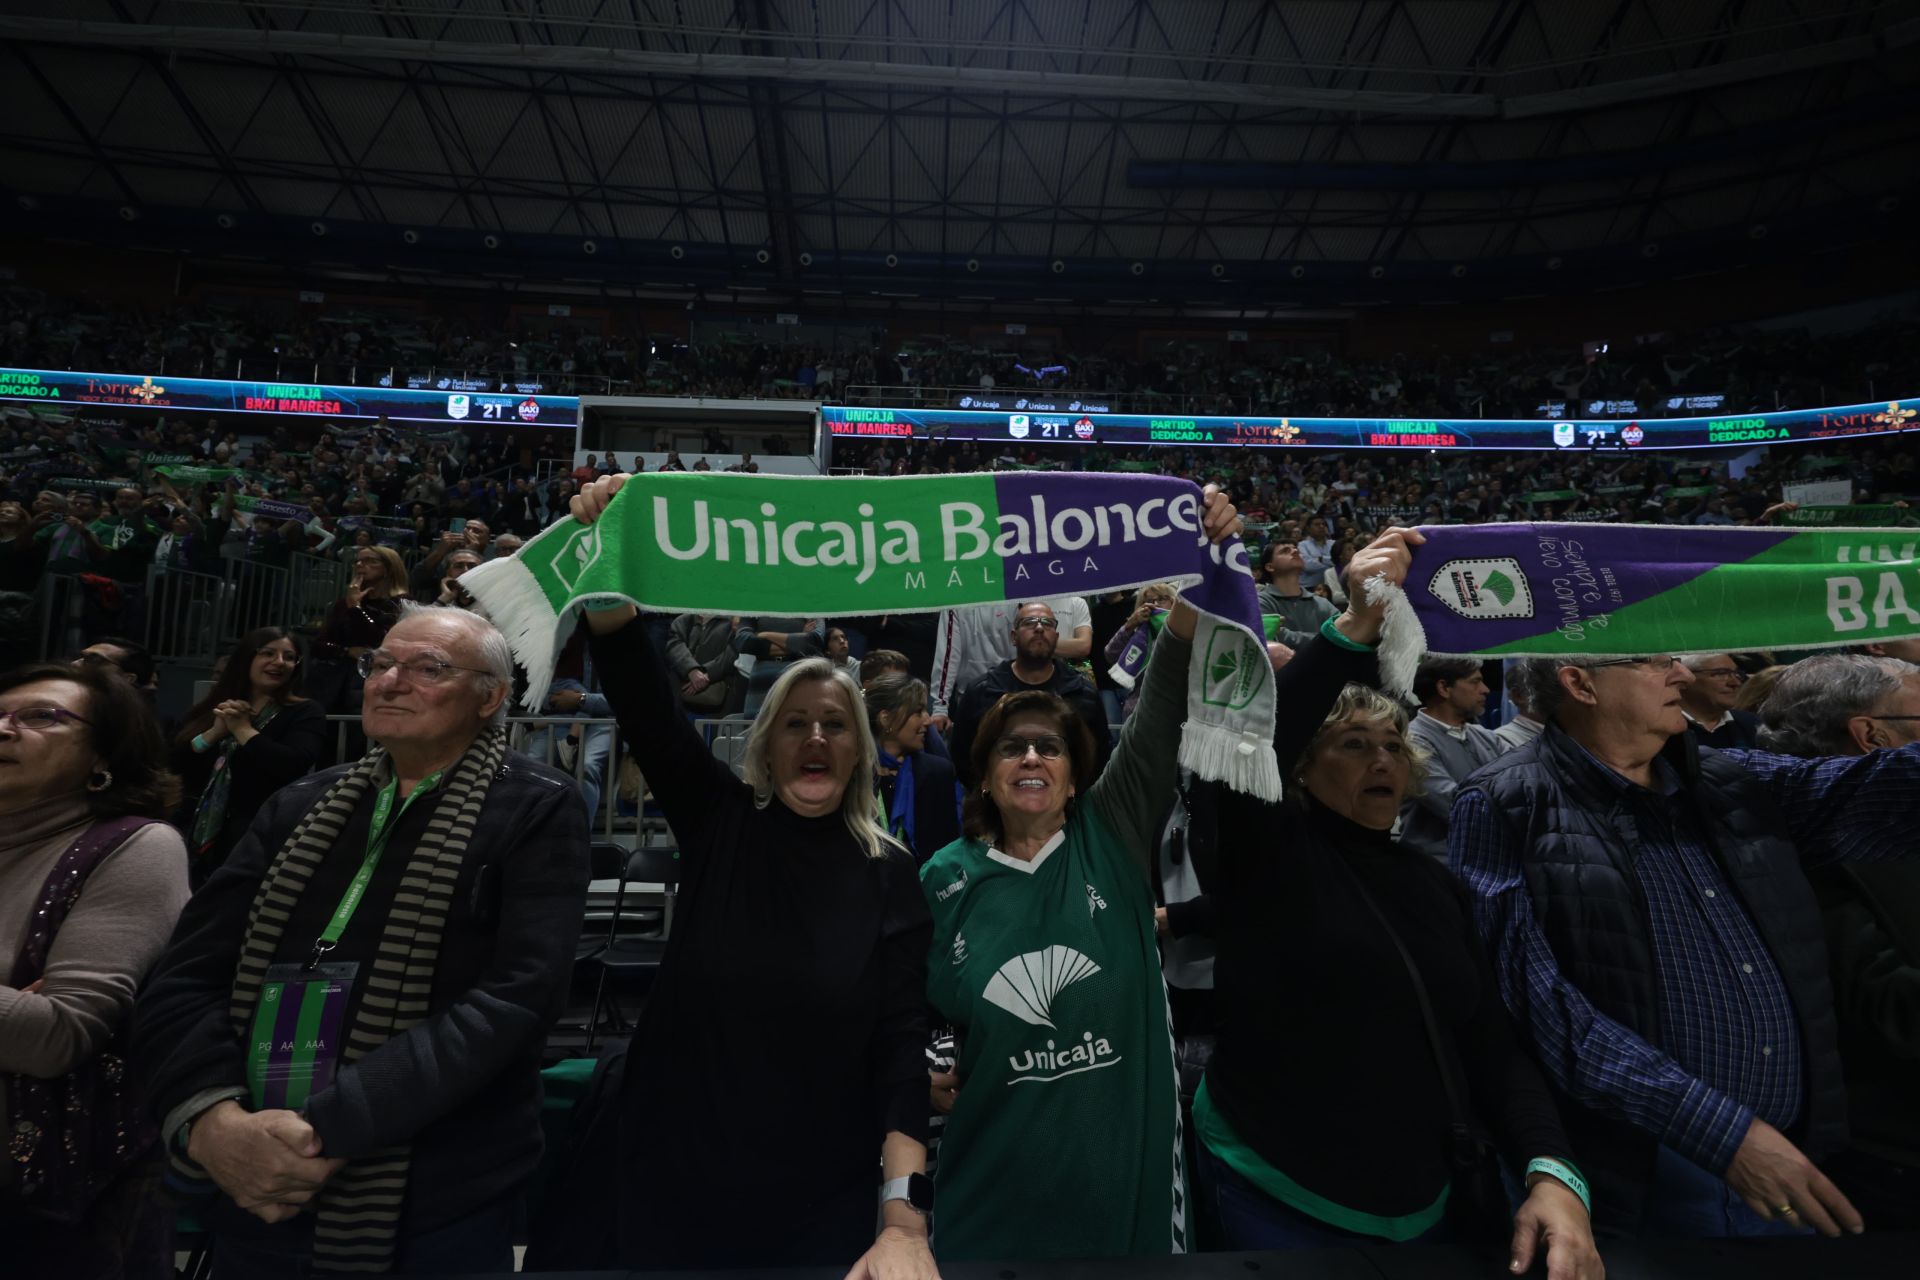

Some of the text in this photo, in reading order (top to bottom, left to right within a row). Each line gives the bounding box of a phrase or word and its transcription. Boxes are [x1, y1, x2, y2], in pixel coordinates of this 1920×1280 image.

[51, 388, 59, 397] A
[267, 386, 321, 400] UNICAJA
[245, 398, 341, 414] BAXI MANRESA
[518, 405, 539, 414] BAXI
[1028, 402, 1055, 411] Unicaa
[845, 409, 894, 422] UNICAJA
[857, 423, 913, 435] MANRESA
[1075, 425, 1094, 433] BAXI
[1151, 420, 1196, 431] PARTIDO
[1388, 421, 1437, 434] UNICAJA
[1709, 419, 1765, 431] PARTIDO
[1151, 430, 1213, 441] DEDICADO A
[1370, 434, 1456, 446] BAXI MANRESA
[1709, 428, 1790, 442] DEDICADO A
[653, 496, 921, 585] Unicaja
[904, 557, 1100, 590] MÁLAGA
[1463, 571, 1484, 607] Unicaja
[1537, 536, 1586, 641] llevo conmigo
[1587, 613, 1613, 629] te
[1086, 883, 1107, 910] ACB
[259, 1039, 325, 1052] PG AA AAA
[1009, 1031, 1112, 1072] Unicaja
[1568, 1177, 1583, 1193] VIP
